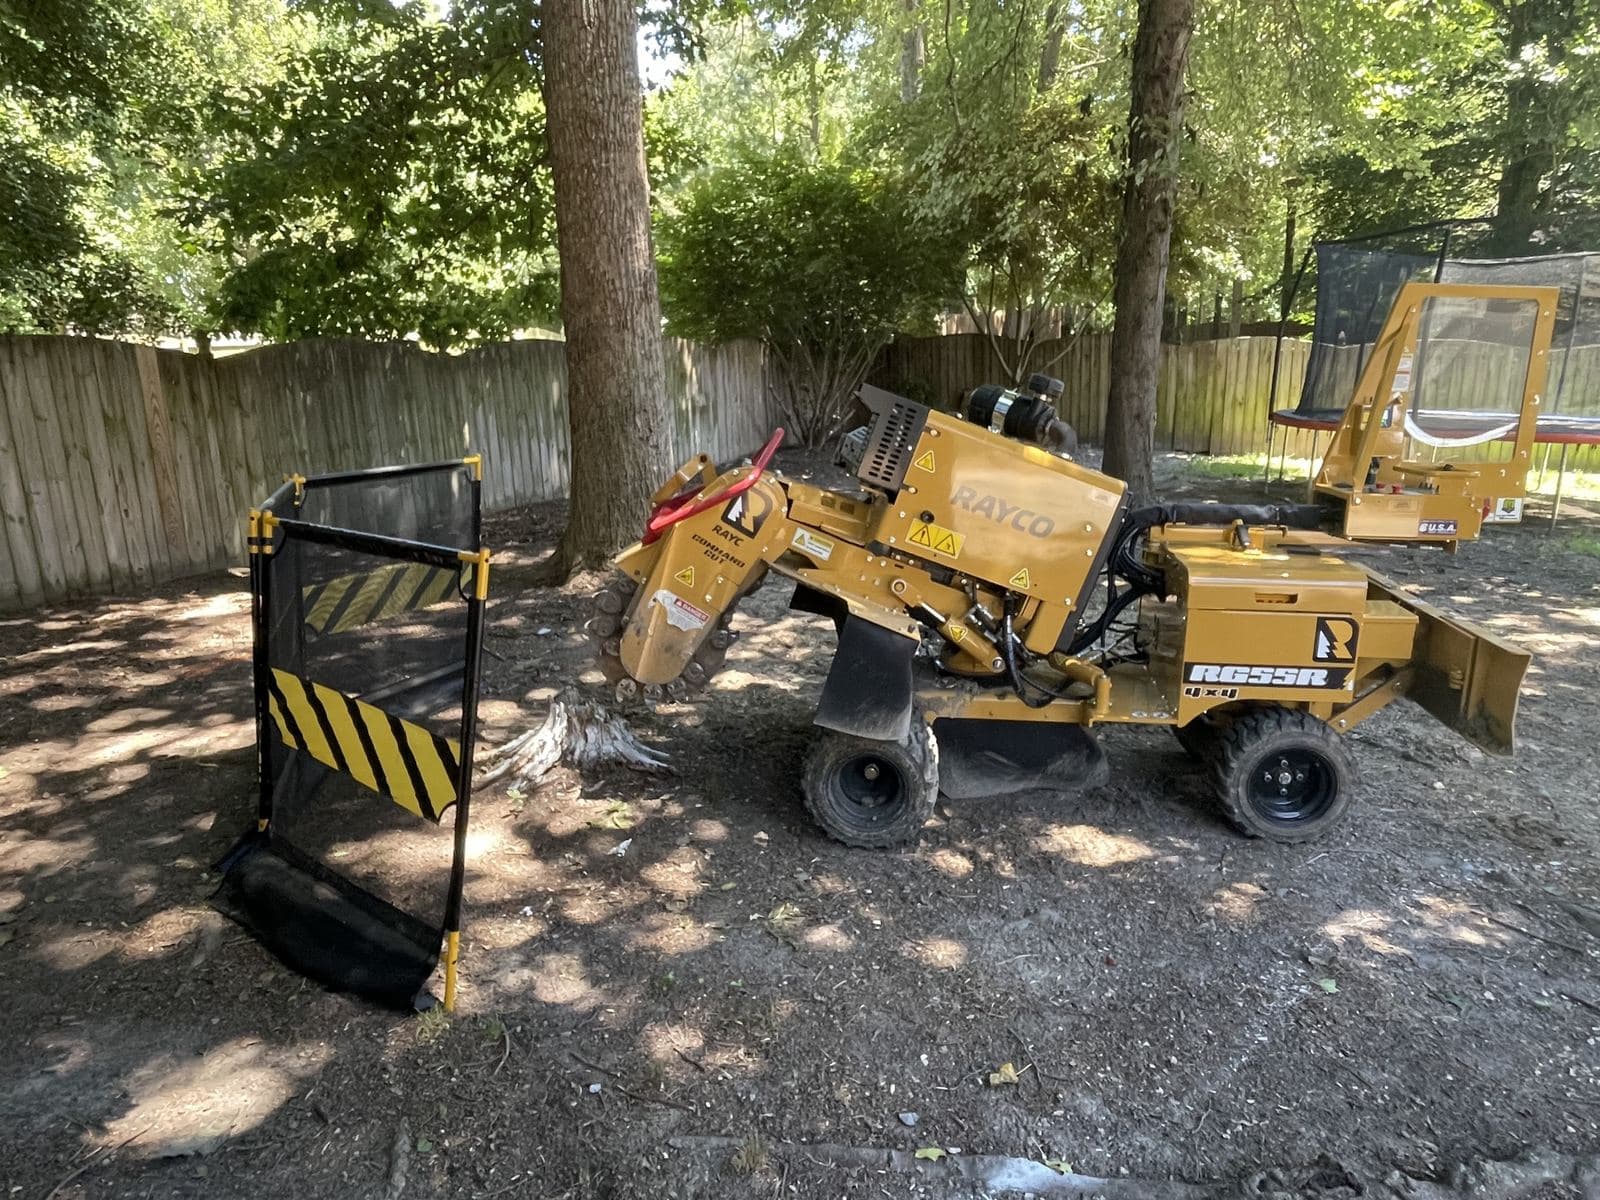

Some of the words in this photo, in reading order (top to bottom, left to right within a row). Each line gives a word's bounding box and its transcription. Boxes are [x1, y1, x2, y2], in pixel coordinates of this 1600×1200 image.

[950, 486, 1055, 538] RAYCO
[691, 533, 746, 568] COMMAND
[703, 549, 725, 564] CUT
[1189, 665, 1328, 686] RG55R
